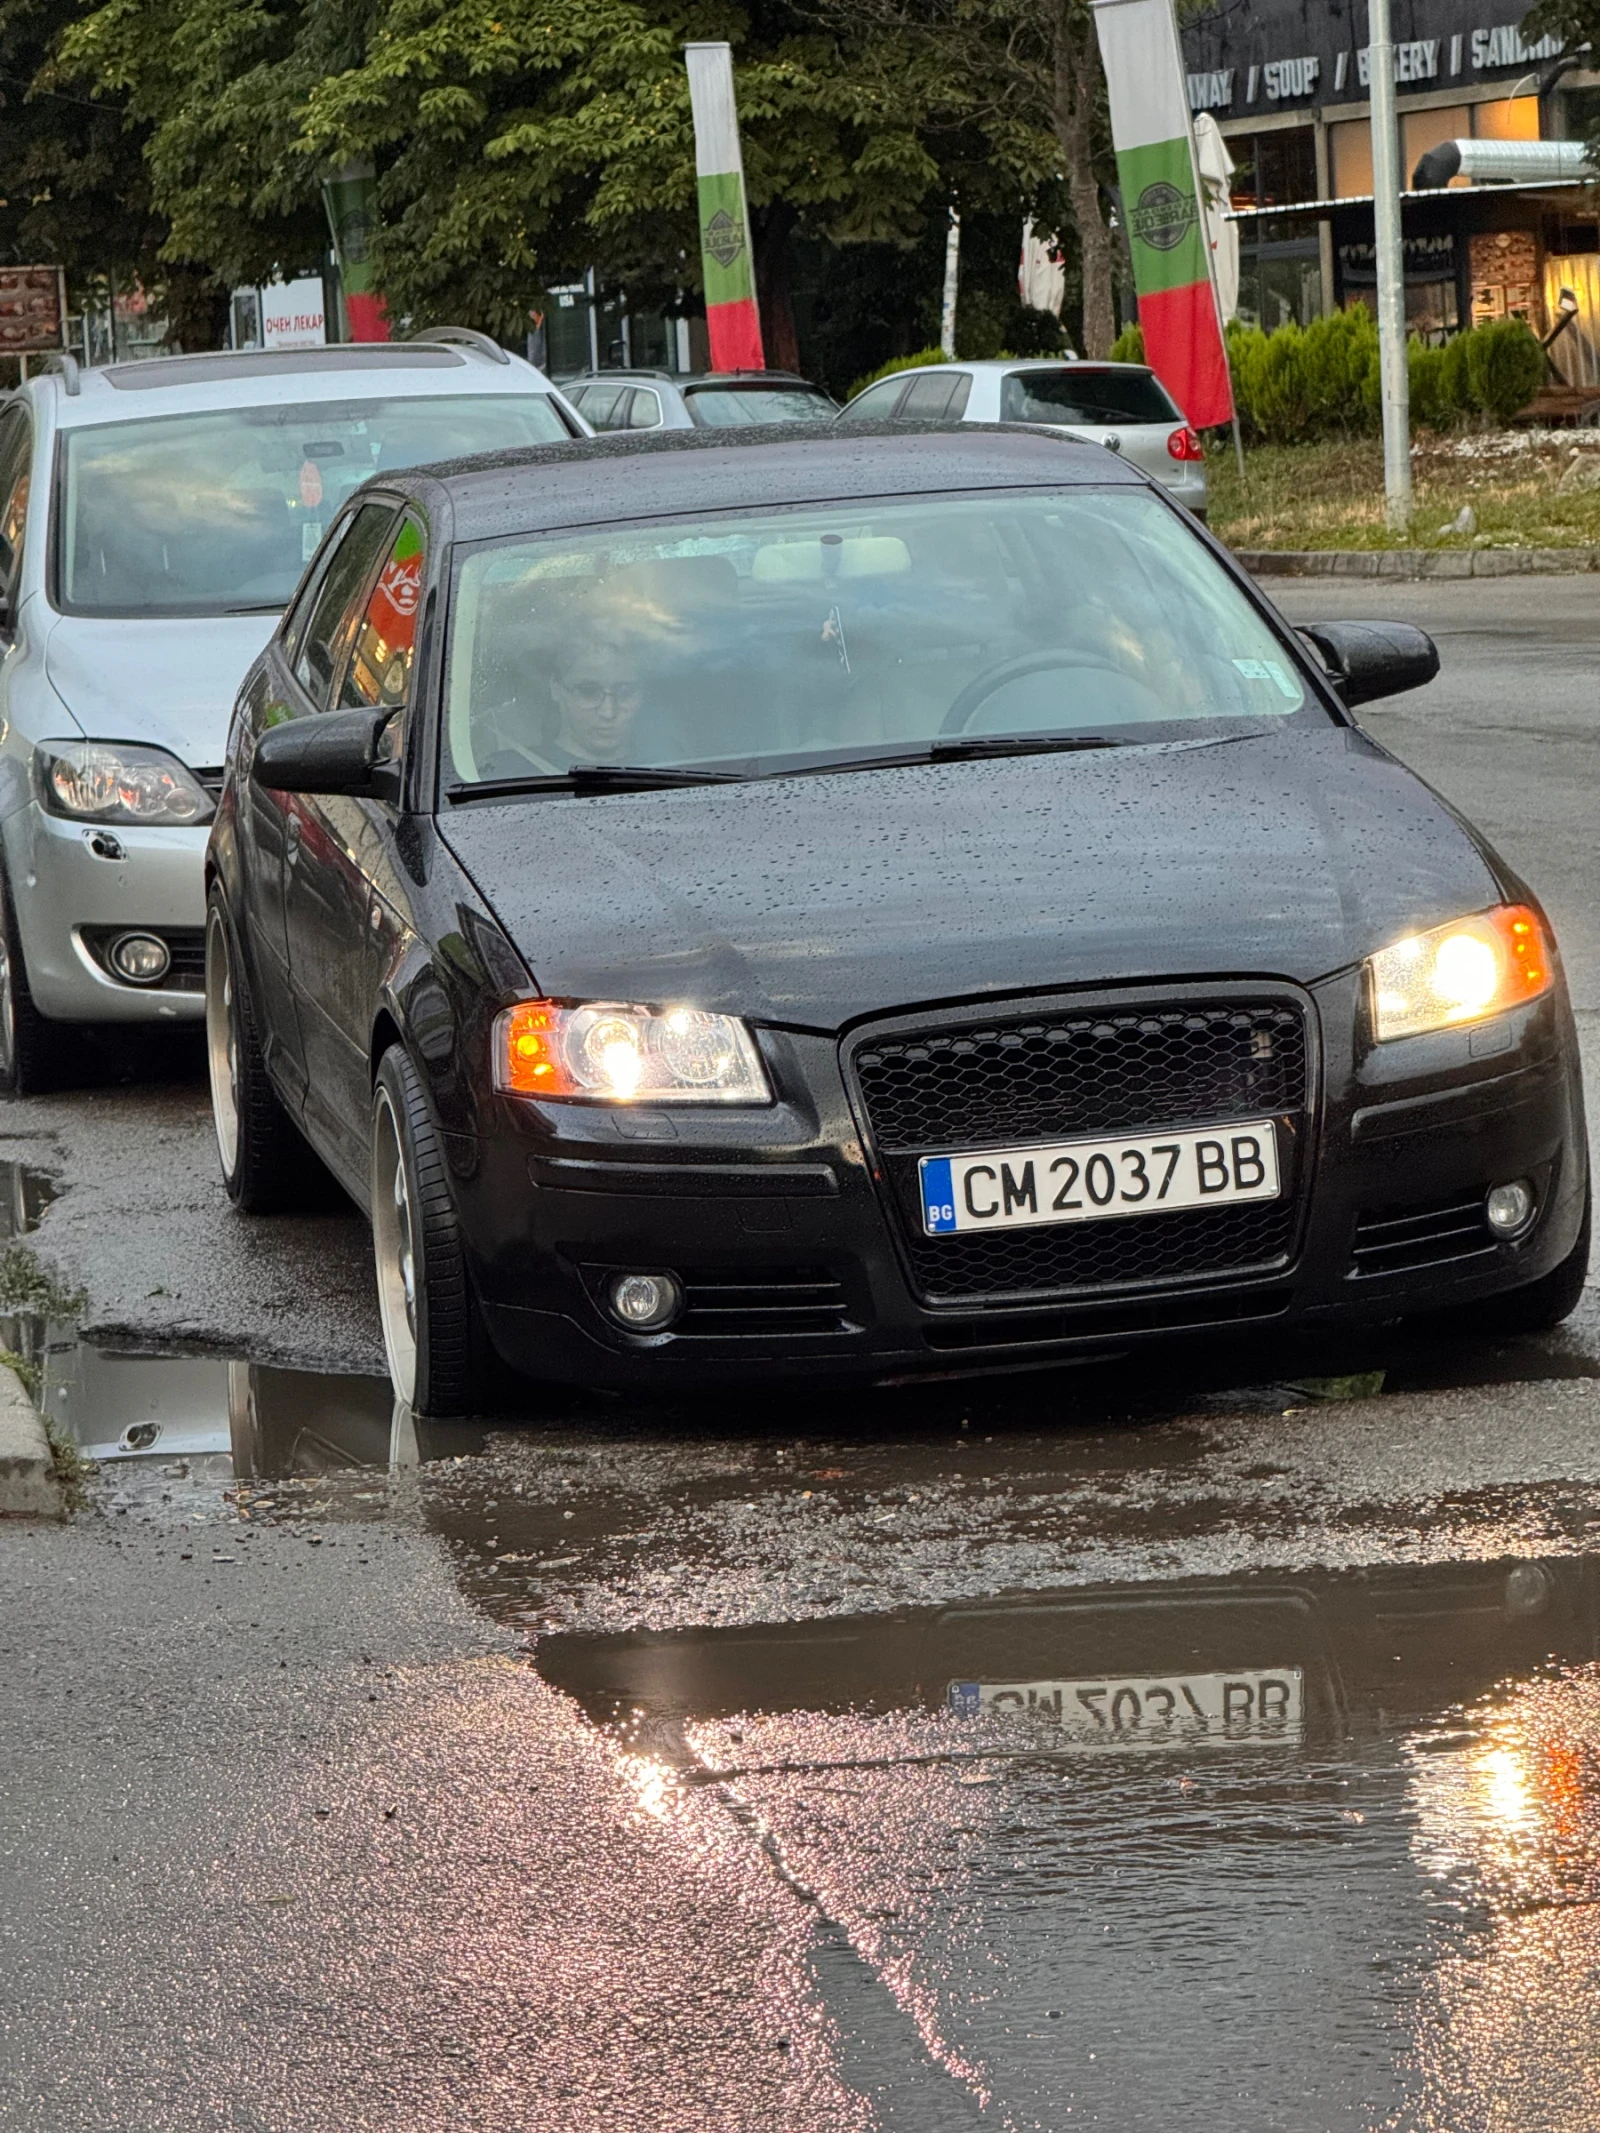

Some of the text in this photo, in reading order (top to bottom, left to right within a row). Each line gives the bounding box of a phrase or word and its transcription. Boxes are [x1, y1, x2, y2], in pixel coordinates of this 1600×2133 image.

[1264, 56, 1319, 100] SOUP
[266, 316, 291, 334] ОЧЕН
[963, 1135, 1266, 1219] CM 2037 BB
[928, 1204, 953, 1222] BG
